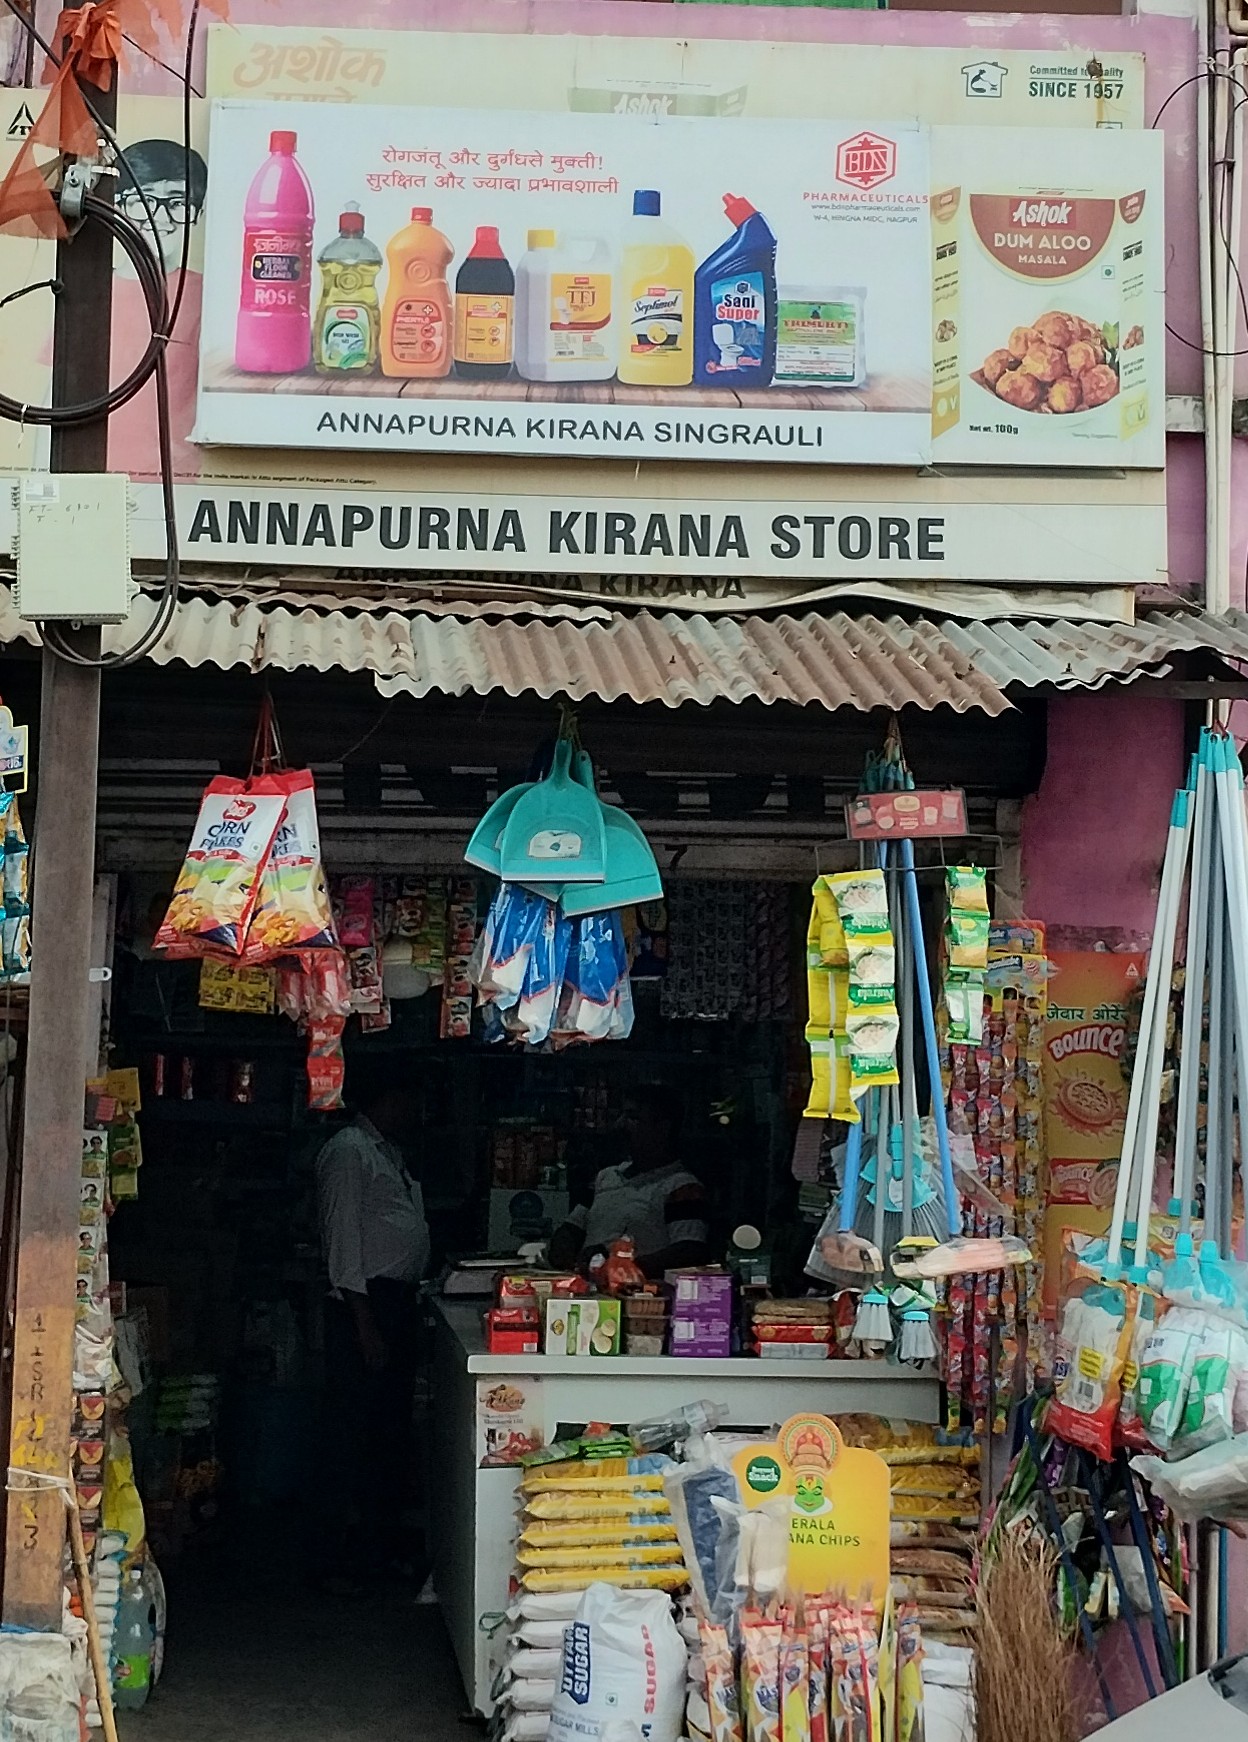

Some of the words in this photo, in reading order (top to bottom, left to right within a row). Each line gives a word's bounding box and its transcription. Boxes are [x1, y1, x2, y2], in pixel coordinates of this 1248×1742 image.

[233, 36, 387, 88] अशोक
[1030, 65, 1078, 76] Committed
[1028, 81, 1077, 98] SINCE
[1084, 83, 1124, 99] 1957
[449, 148, 481, 166] और
[366, 170, 427, 192] सुरक्षित
[433, 172, 466, 190] और
[473, 176, 520, 192] ज्यादा
[528, 177, 620, 194] प्रभावशाली
[803, 192, 929, 204] PHARMACEUTICALS
[1013, 200, 1072, 227] Ashok
[994, 232, 1034, 249] DUM
[1038, 236, 1091, 251] ALOO
[1018, 254, 1067, 265] MASALA
[255, 288, 297, 305] ROSE
[566, 291, 596, 306] TEJ
[724, 294, 755, 308] Sani
[718, 306, 760, 320] Super
[317, 412, 516, 438] ANNAPURNA
[526, 418, 644, 440] KIRANA
[654, 422, 823, 447] SINGRAULI
[995, 424, 1019, 434] 100g
[188, 500, 527, 553] ANNAPURNA
[549, 511, 749, 558] KIRANA
[770, 515, 944, 560] STORE
[600, 574, 746, 599] KIRANA
[791, 1518, 835, 1531] ERALA
[789, 1533, 815, 1545] ANA
[819, 1534, 860, 1546] CHIPS
[561, 1628, 575, 1692] UTTAR
[574, 1626, 589, 1696] SUGAR
